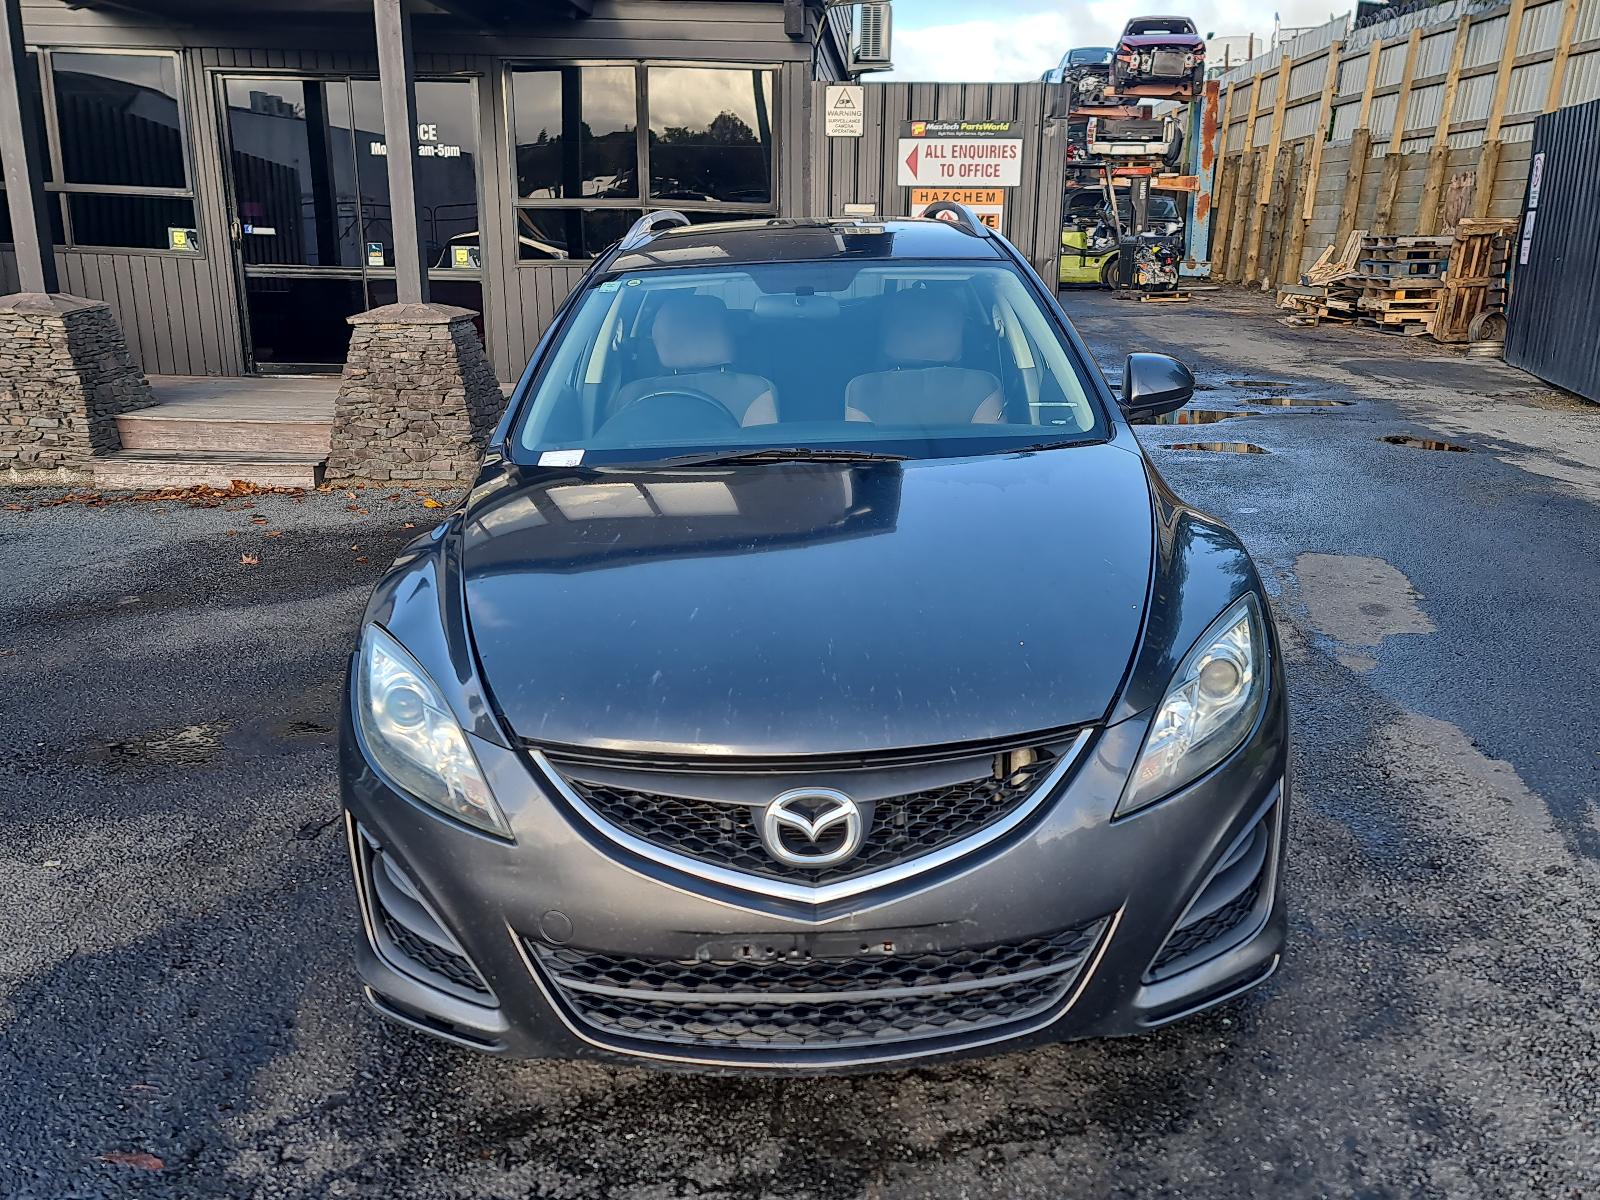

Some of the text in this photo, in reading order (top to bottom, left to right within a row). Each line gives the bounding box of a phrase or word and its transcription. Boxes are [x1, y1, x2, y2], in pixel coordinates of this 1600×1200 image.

[960, 122, 1010, 131] PartsWorld
[418, 144, 460, 158] am-5pm
[925, 145, 1017, 160] ALL ENQUIRIES
[940, 164, 1001, 178] TO OFFICE
[920, 192, 996, 202] HAZCHEM
